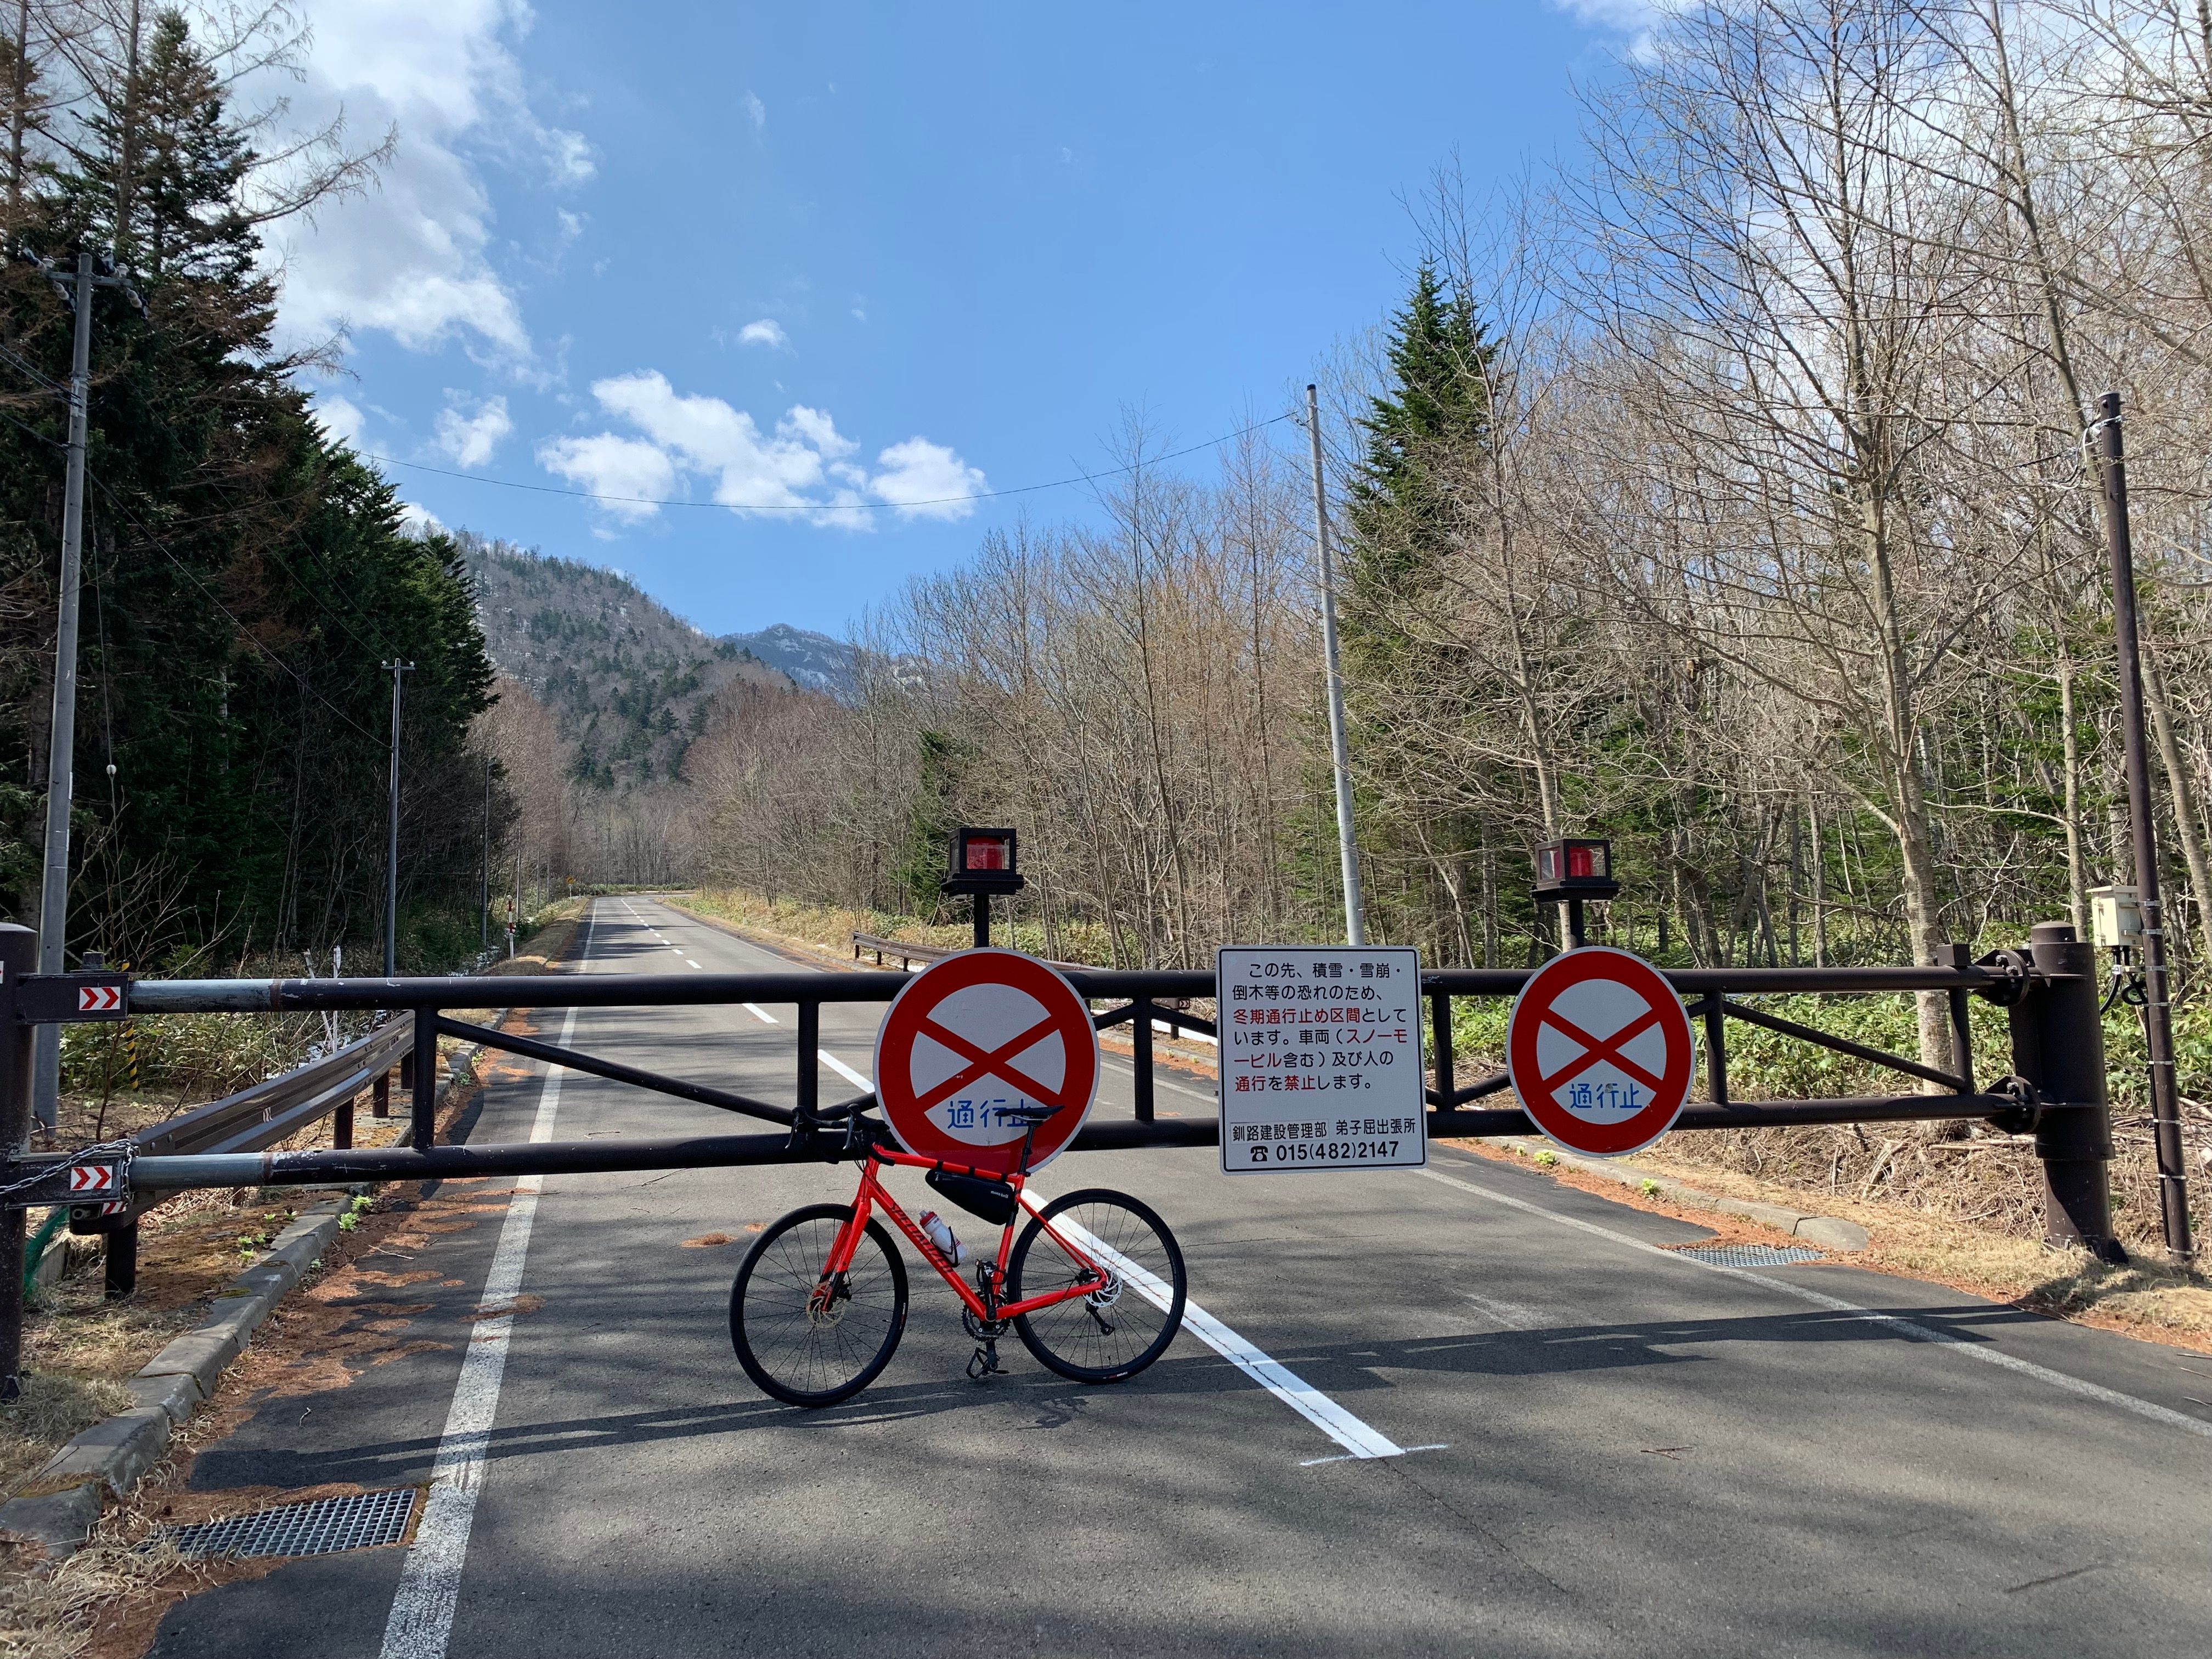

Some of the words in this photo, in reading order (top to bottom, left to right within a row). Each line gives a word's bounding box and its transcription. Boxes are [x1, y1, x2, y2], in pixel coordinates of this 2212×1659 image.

[1232, 985, 1383, 1001] 倒木等の恐れのため、
[1233, 1008, 1407, 1024] 冬期通行止め区間として
[1235, 1073, 1372, 1092] 通行を禁止します。
[1569, 1082, 1643, 1109] 通行止
[1232, 1121, 1327, 1142] 釧路建設管理部
[1335, 1118, 1416, 1136] 弟子屈出張所
